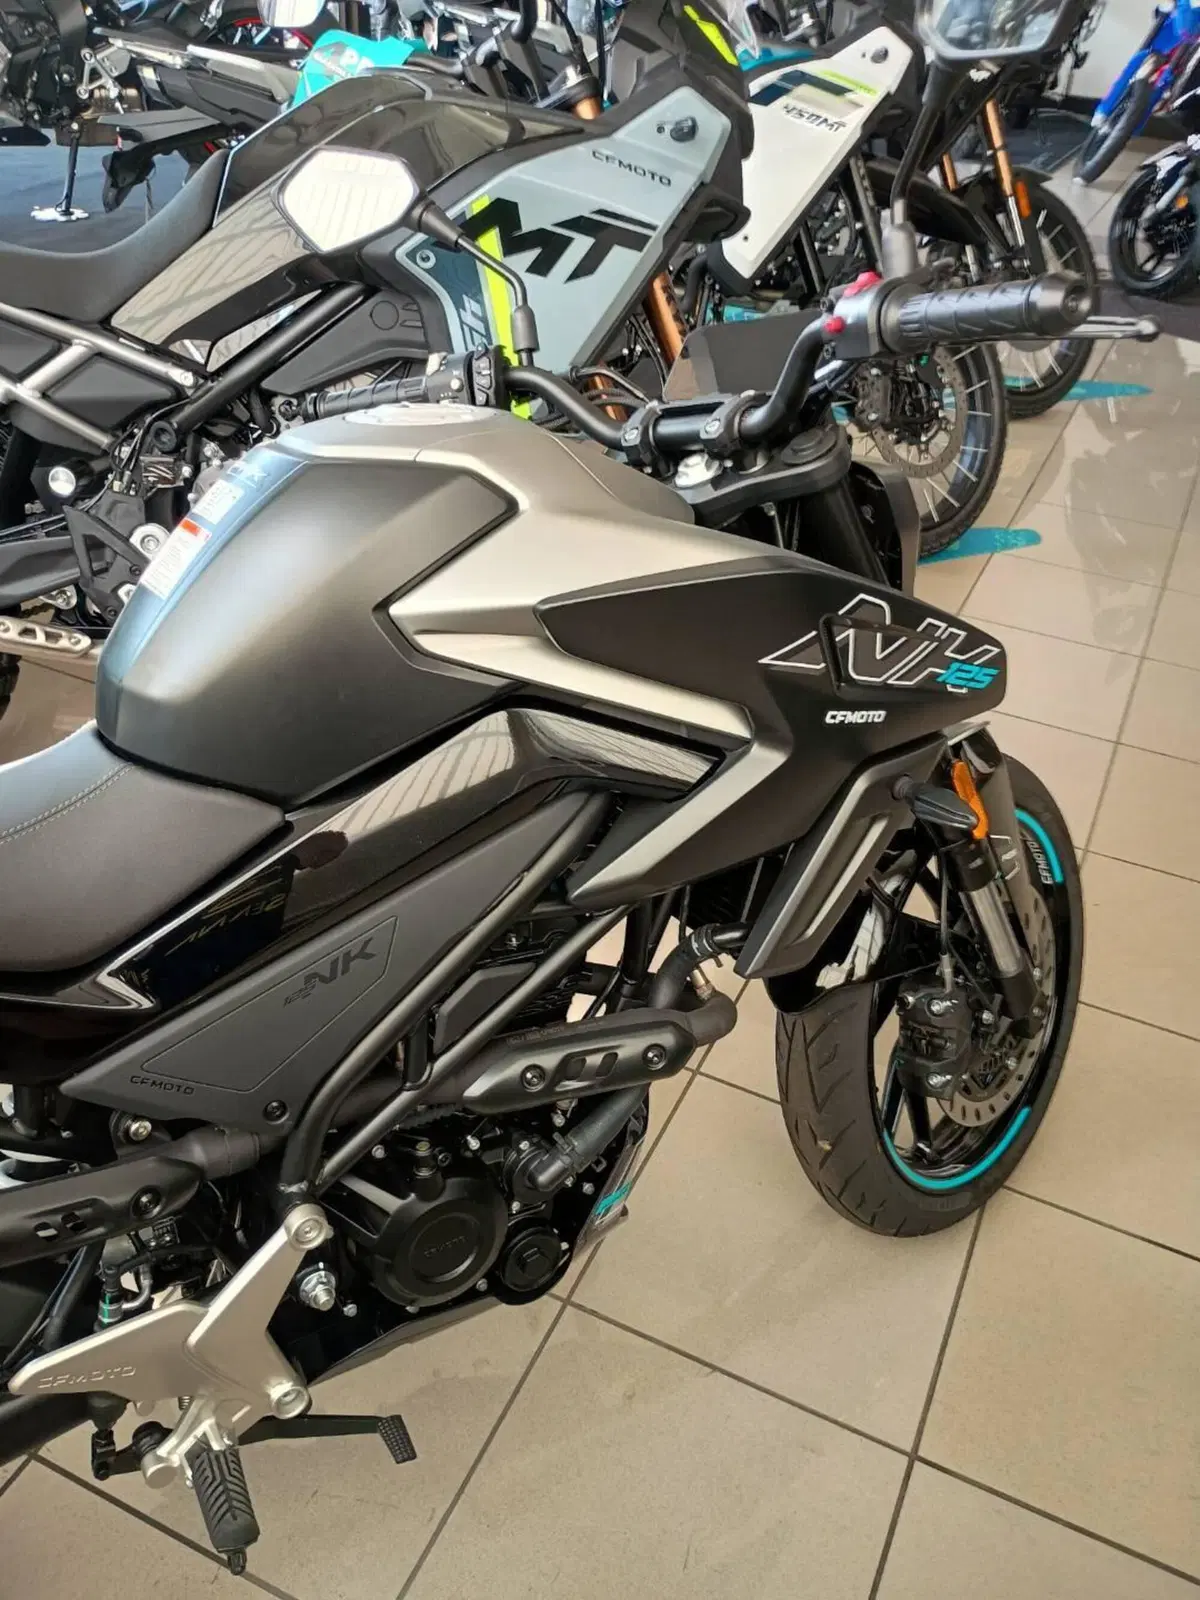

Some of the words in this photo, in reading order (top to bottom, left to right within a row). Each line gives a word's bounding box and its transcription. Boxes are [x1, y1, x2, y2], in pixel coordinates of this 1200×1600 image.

[782, 102, 847, 133] 450MT
[592, 150, 672, 187] CFMOTO
[431, 197, 659, 285] MT
[935, 661, 1001, 690] 125
[824, 710, 887, 724] CFMOTO
[130, 1075, 195, 1095] CFMOTO
[37, 1365, 137, 1389] CFMOTO
